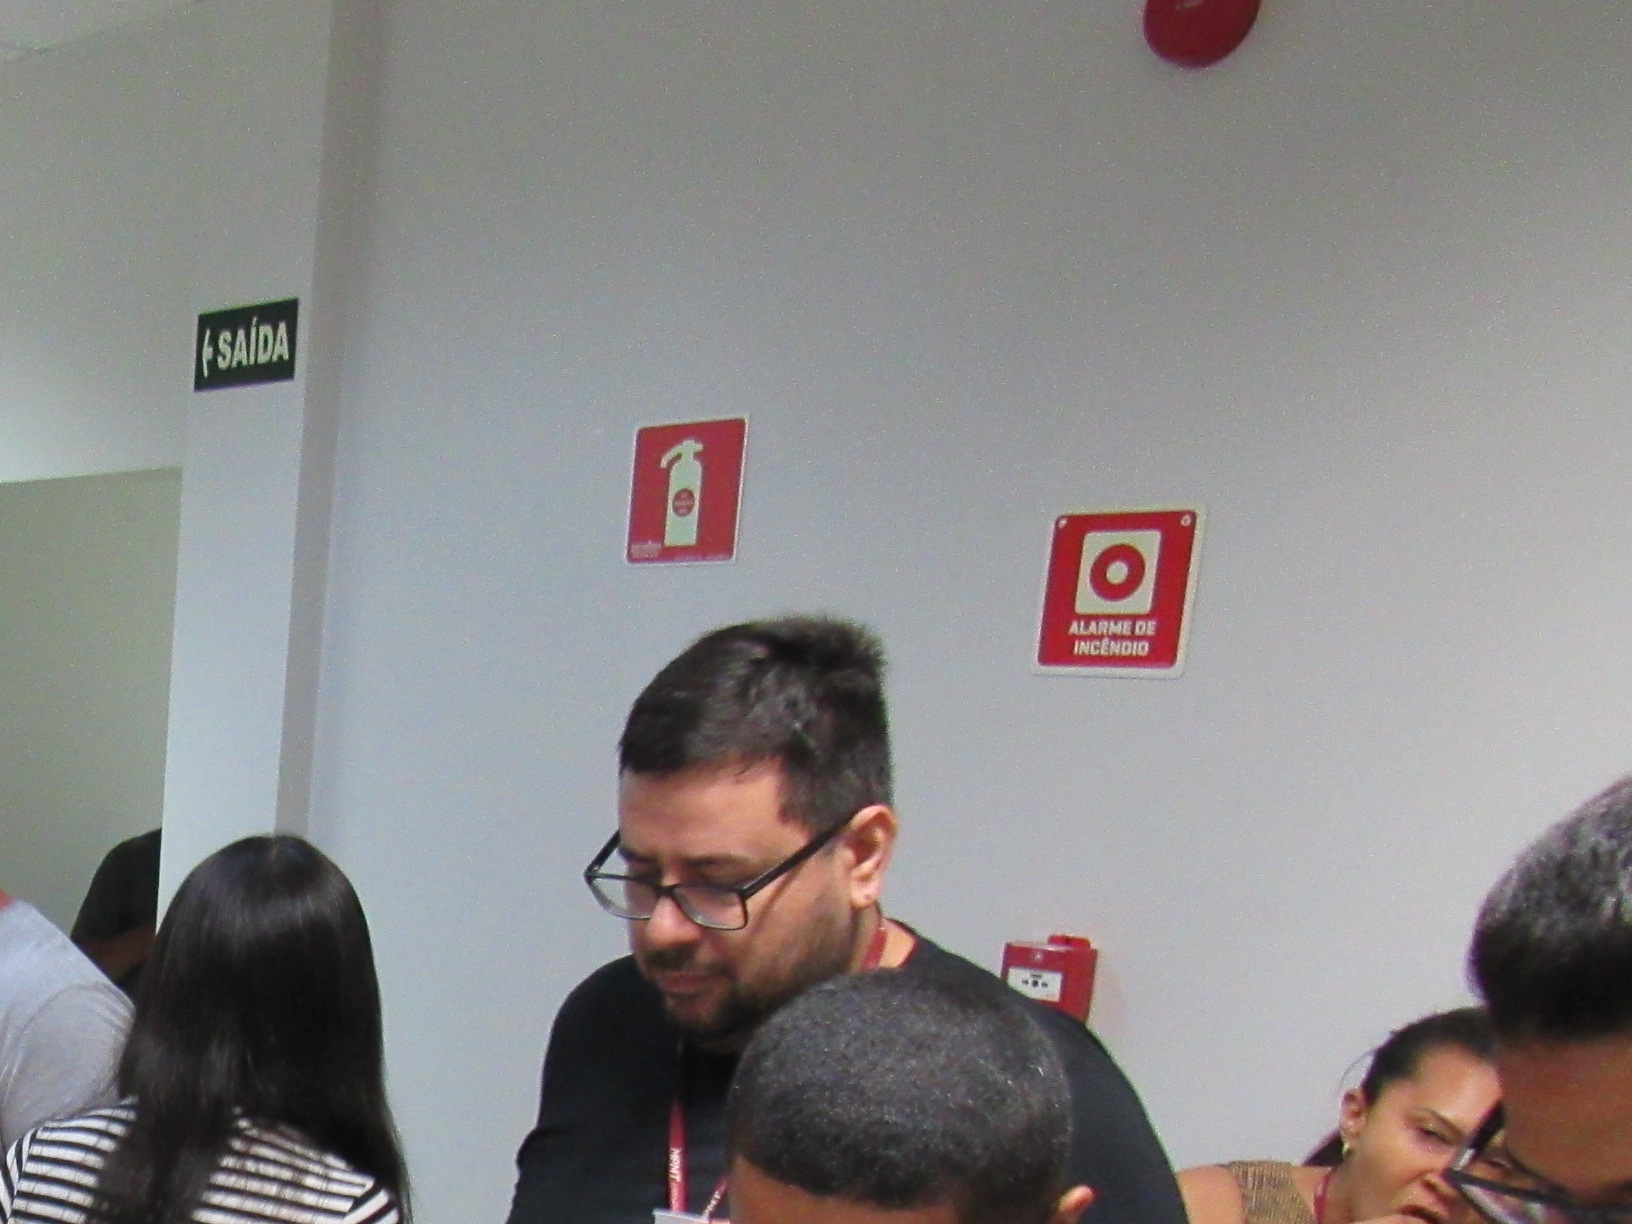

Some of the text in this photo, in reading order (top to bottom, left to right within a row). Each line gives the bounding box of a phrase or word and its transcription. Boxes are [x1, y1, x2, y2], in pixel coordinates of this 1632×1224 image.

[216, 315, 290, 370] SAÍDA
[1068, 619, 1157, 636] ALARME DE
[1073, 636, 1149, 656] INCÊNDIO
